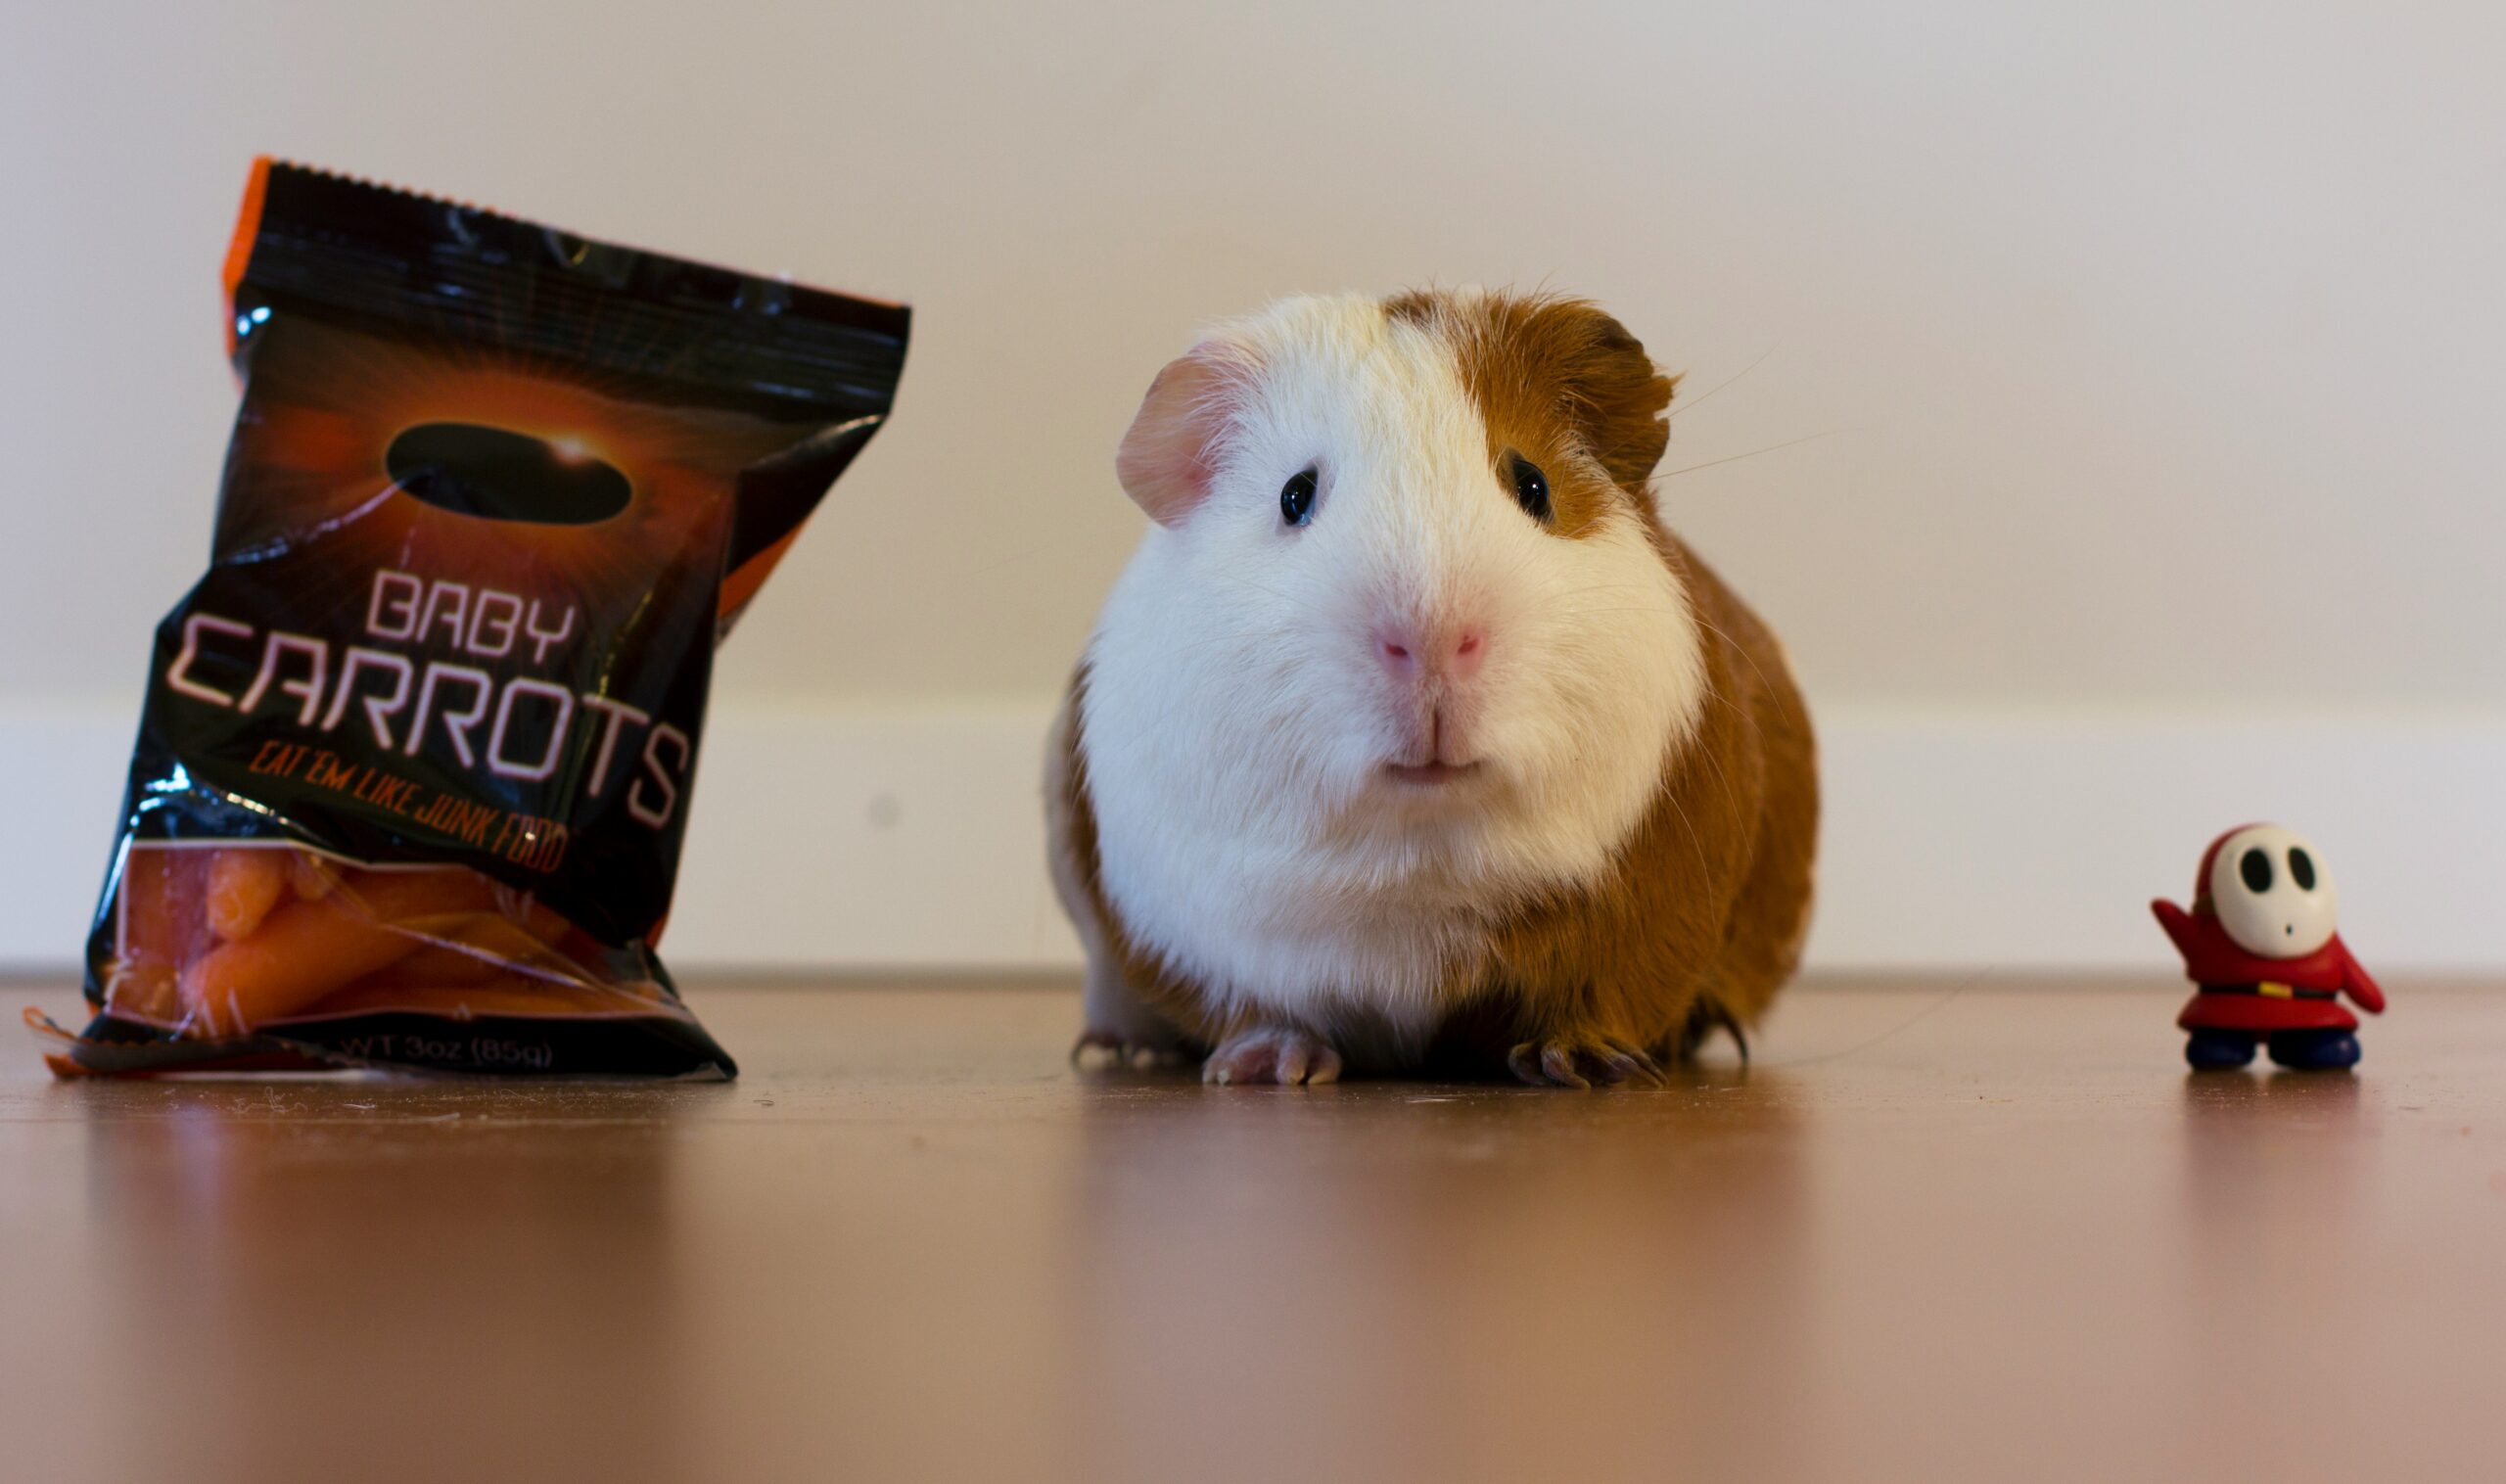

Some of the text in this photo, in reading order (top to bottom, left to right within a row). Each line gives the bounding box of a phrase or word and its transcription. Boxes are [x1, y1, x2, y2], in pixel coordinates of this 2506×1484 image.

[365, 569, 576, 664] BABY
[166, 612, 690, 829] CARROTS
[249, 739, 313, 777] EAT
[351, 766, 424, 816] LIKE
[414, 792, 500, 849] JUNK
[490, 812, 569, 874] FOOD
[339, 1034, 395, 1058] WT
[404, 1034, 463, 1059] 3oz
